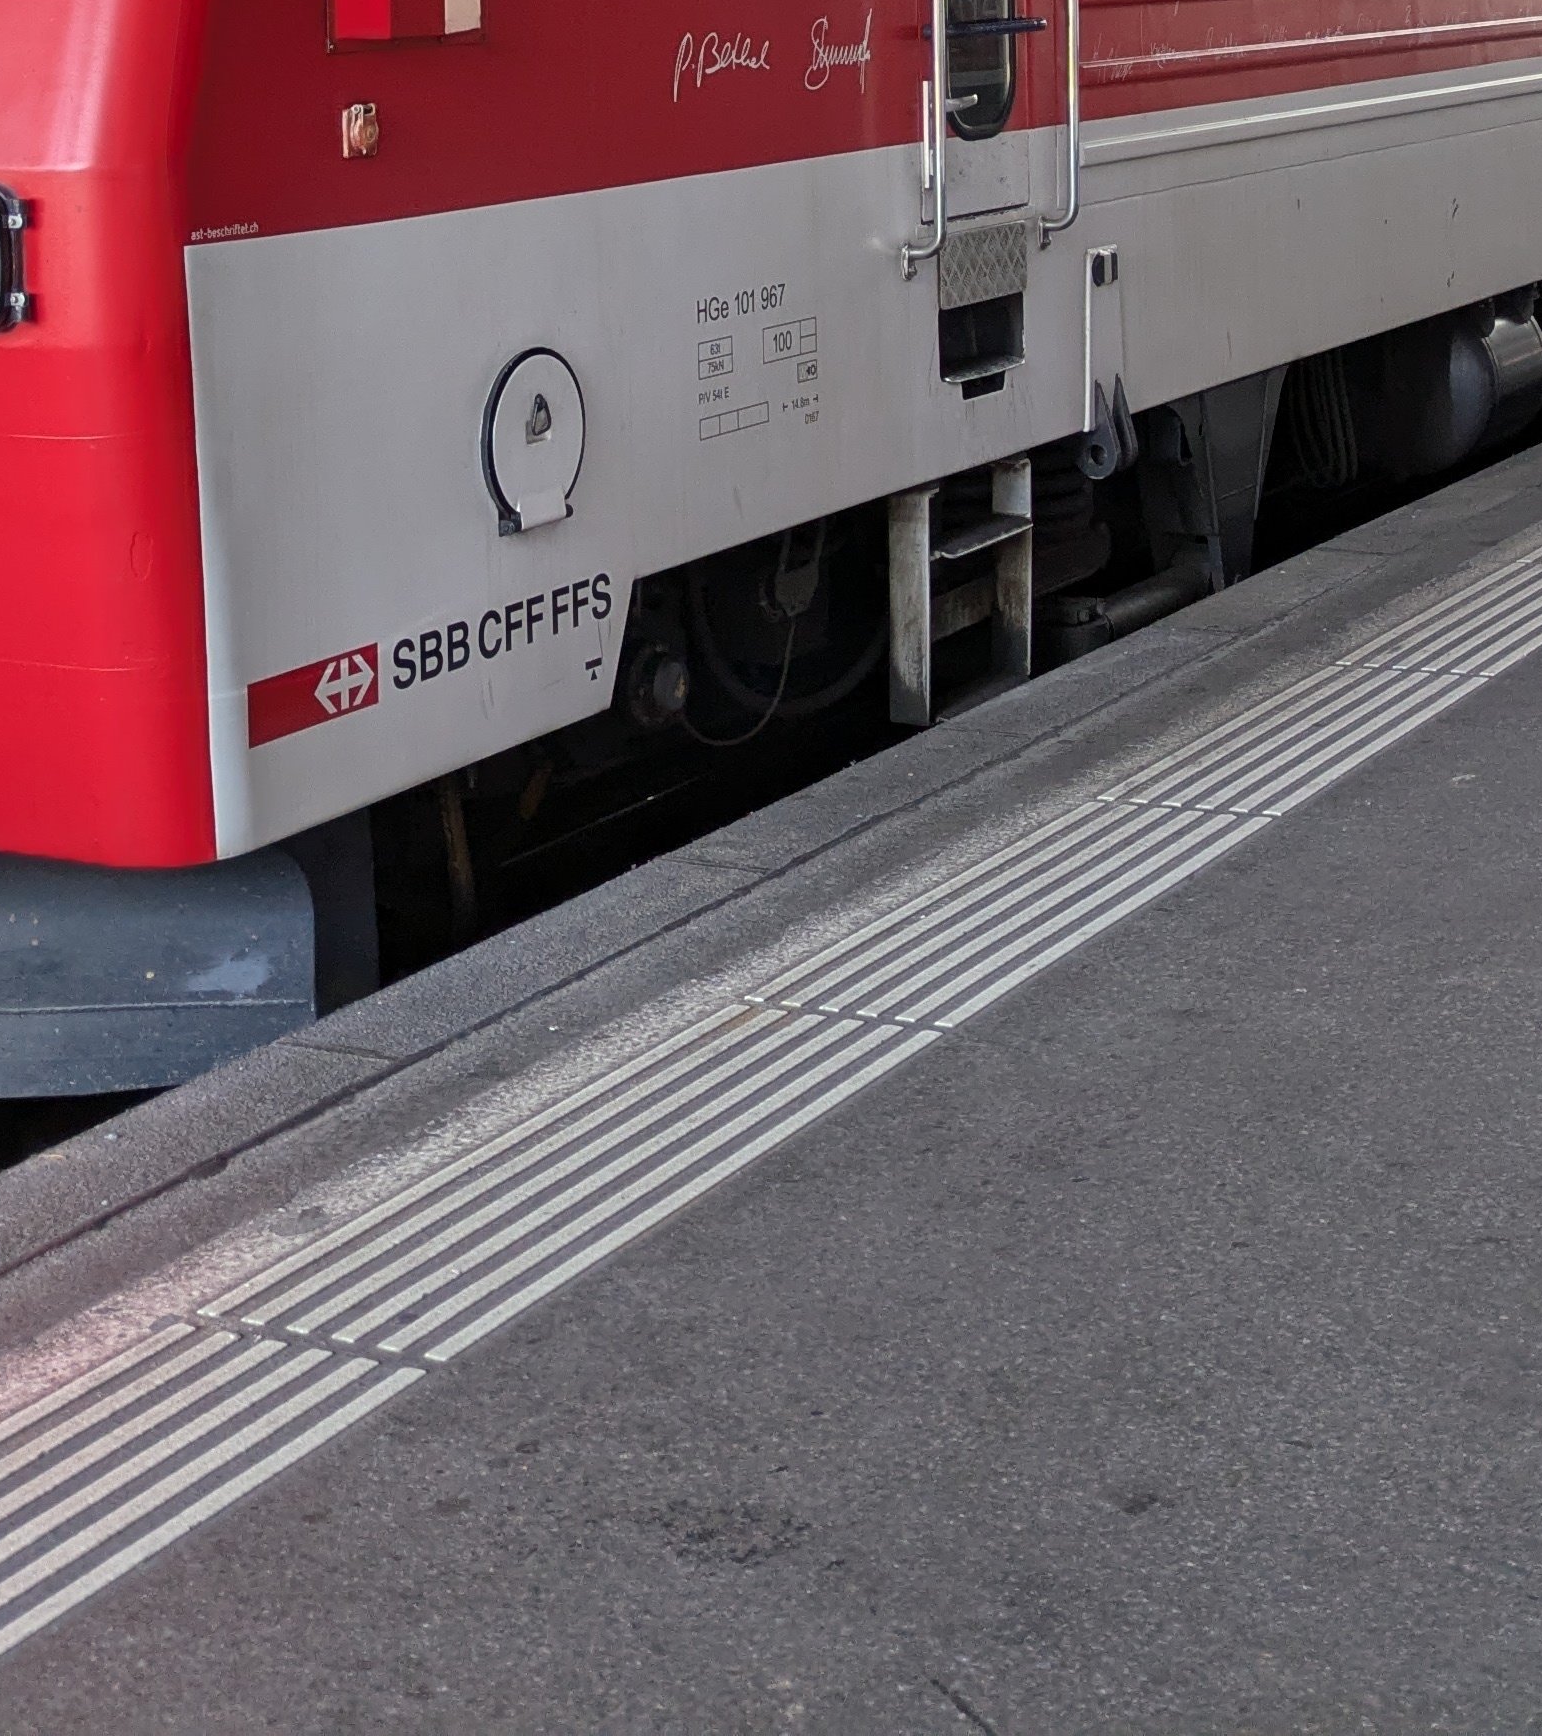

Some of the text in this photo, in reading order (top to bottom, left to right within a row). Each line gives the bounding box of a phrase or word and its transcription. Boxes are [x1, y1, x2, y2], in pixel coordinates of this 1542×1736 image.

[190, 222, 259, 241] ast-beschriftet.ch
[697, 283, 786, 324] HGe 101 967
[772, 330, 793, 353] 100
[392, 573, 612, 690] SBB CFF FFS
